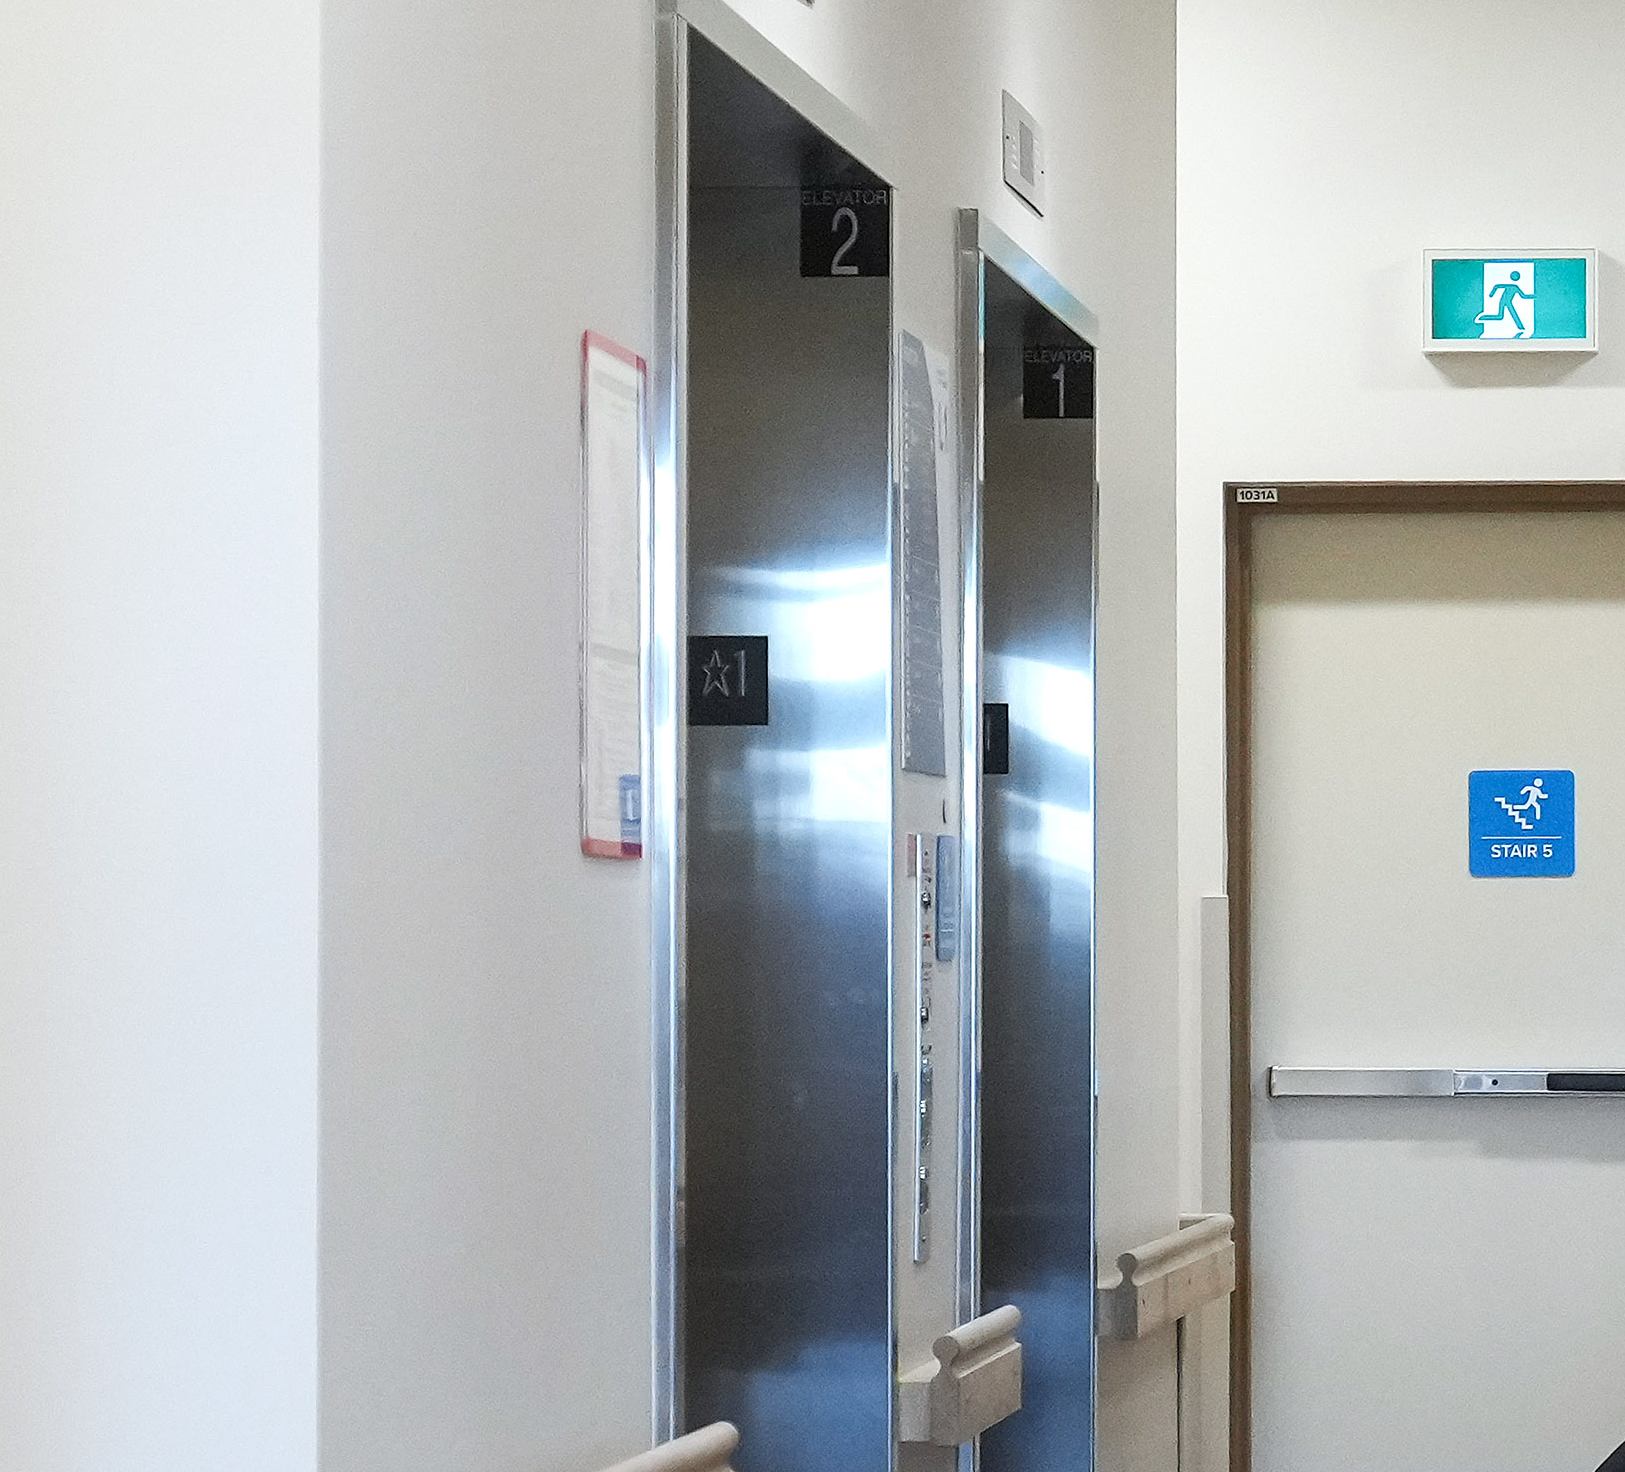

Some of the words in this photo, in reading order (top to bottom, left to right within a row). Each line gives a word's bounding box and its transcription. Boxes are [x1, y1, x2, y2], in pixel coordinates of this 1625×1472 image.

[801, 189, 887, 206] ELEVATOR
[830, 207, 859, 275] 2
[1052, 363, 1065, 417] 1
[1239, 490, 1275, 500] 1031A
[1490, 844, 1538, 858] STAIR
[1542, 844, 1553, 858] 5
